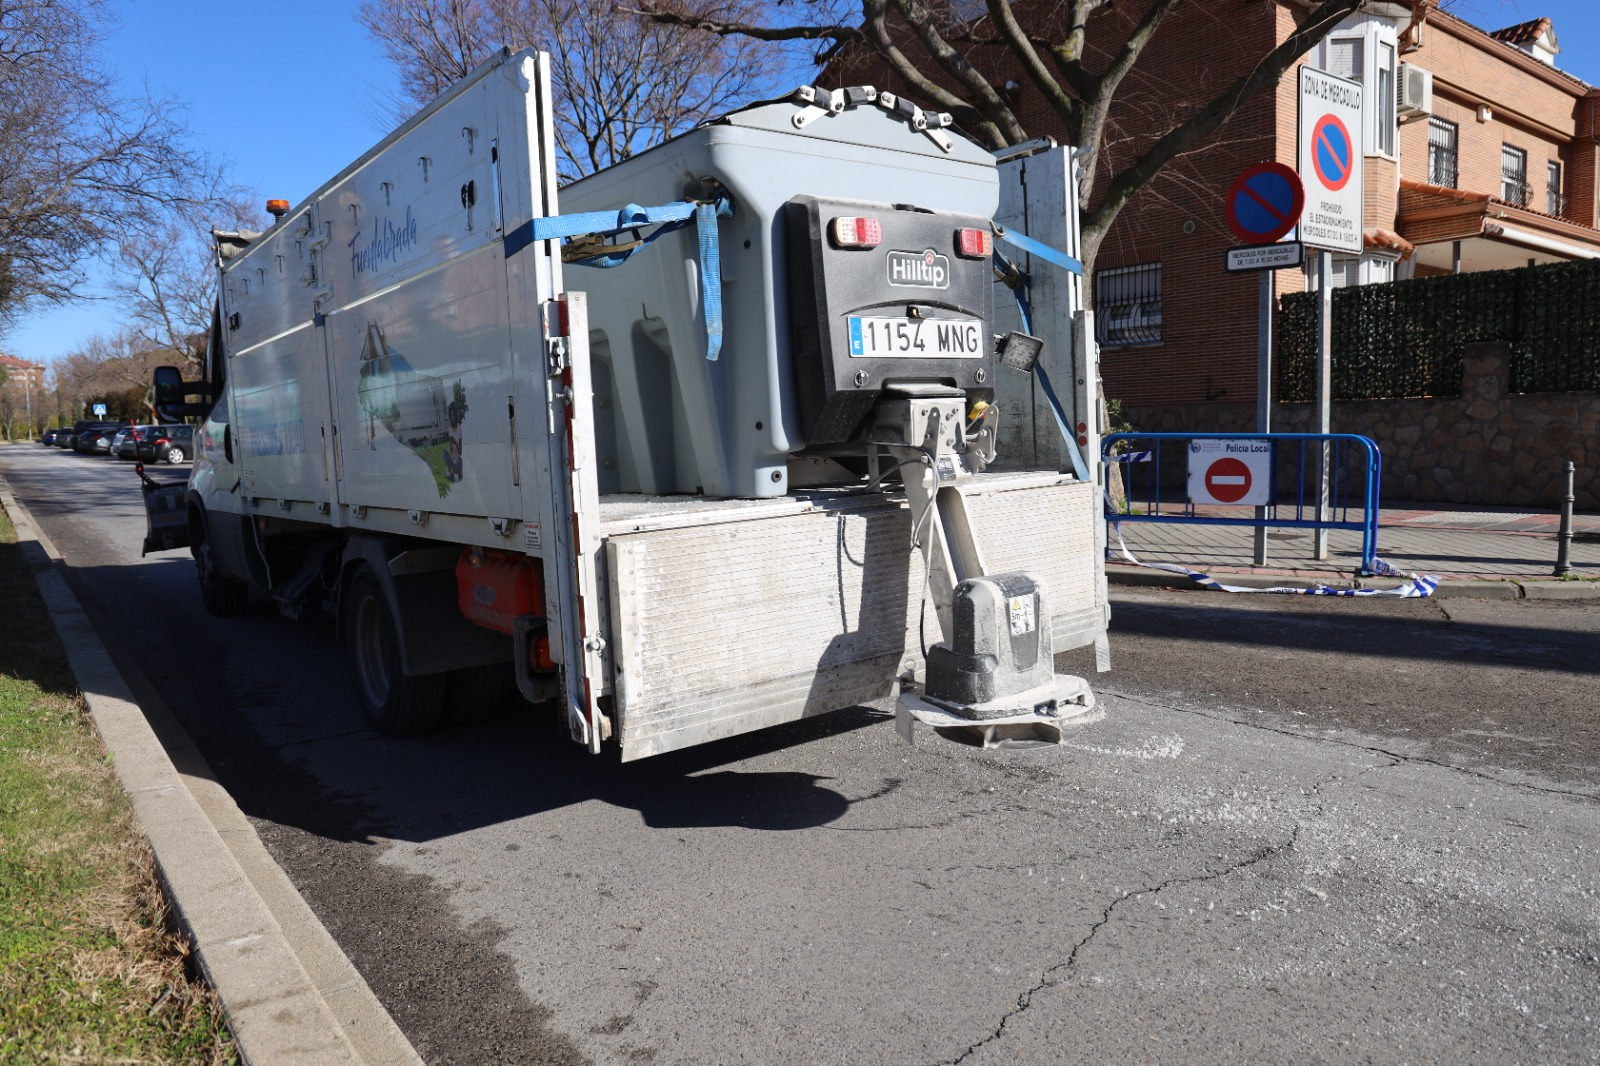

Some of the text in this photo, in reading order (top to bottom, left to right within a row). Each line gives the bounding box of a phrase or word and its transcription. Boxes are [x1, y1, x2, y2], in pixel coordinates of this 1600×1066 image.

[1304, 75, 1361, 110] ZONA DE MERCADILLO
[1320, 201, 1342, 214] PROHIBIDO
[1309, 212, 1353, 230] EL ESTACIONAMIENTO
[348, 205, 417, 282] Fuenlabrada
[1267, 247, 1295, 255] MERCADILLO
[892, 257, 945, 287] Hilltip
[854, 340, 860, 349] E
[868, 321, 978, 353] 1154 MNG
[1250, 444, 1270, 453] Local
